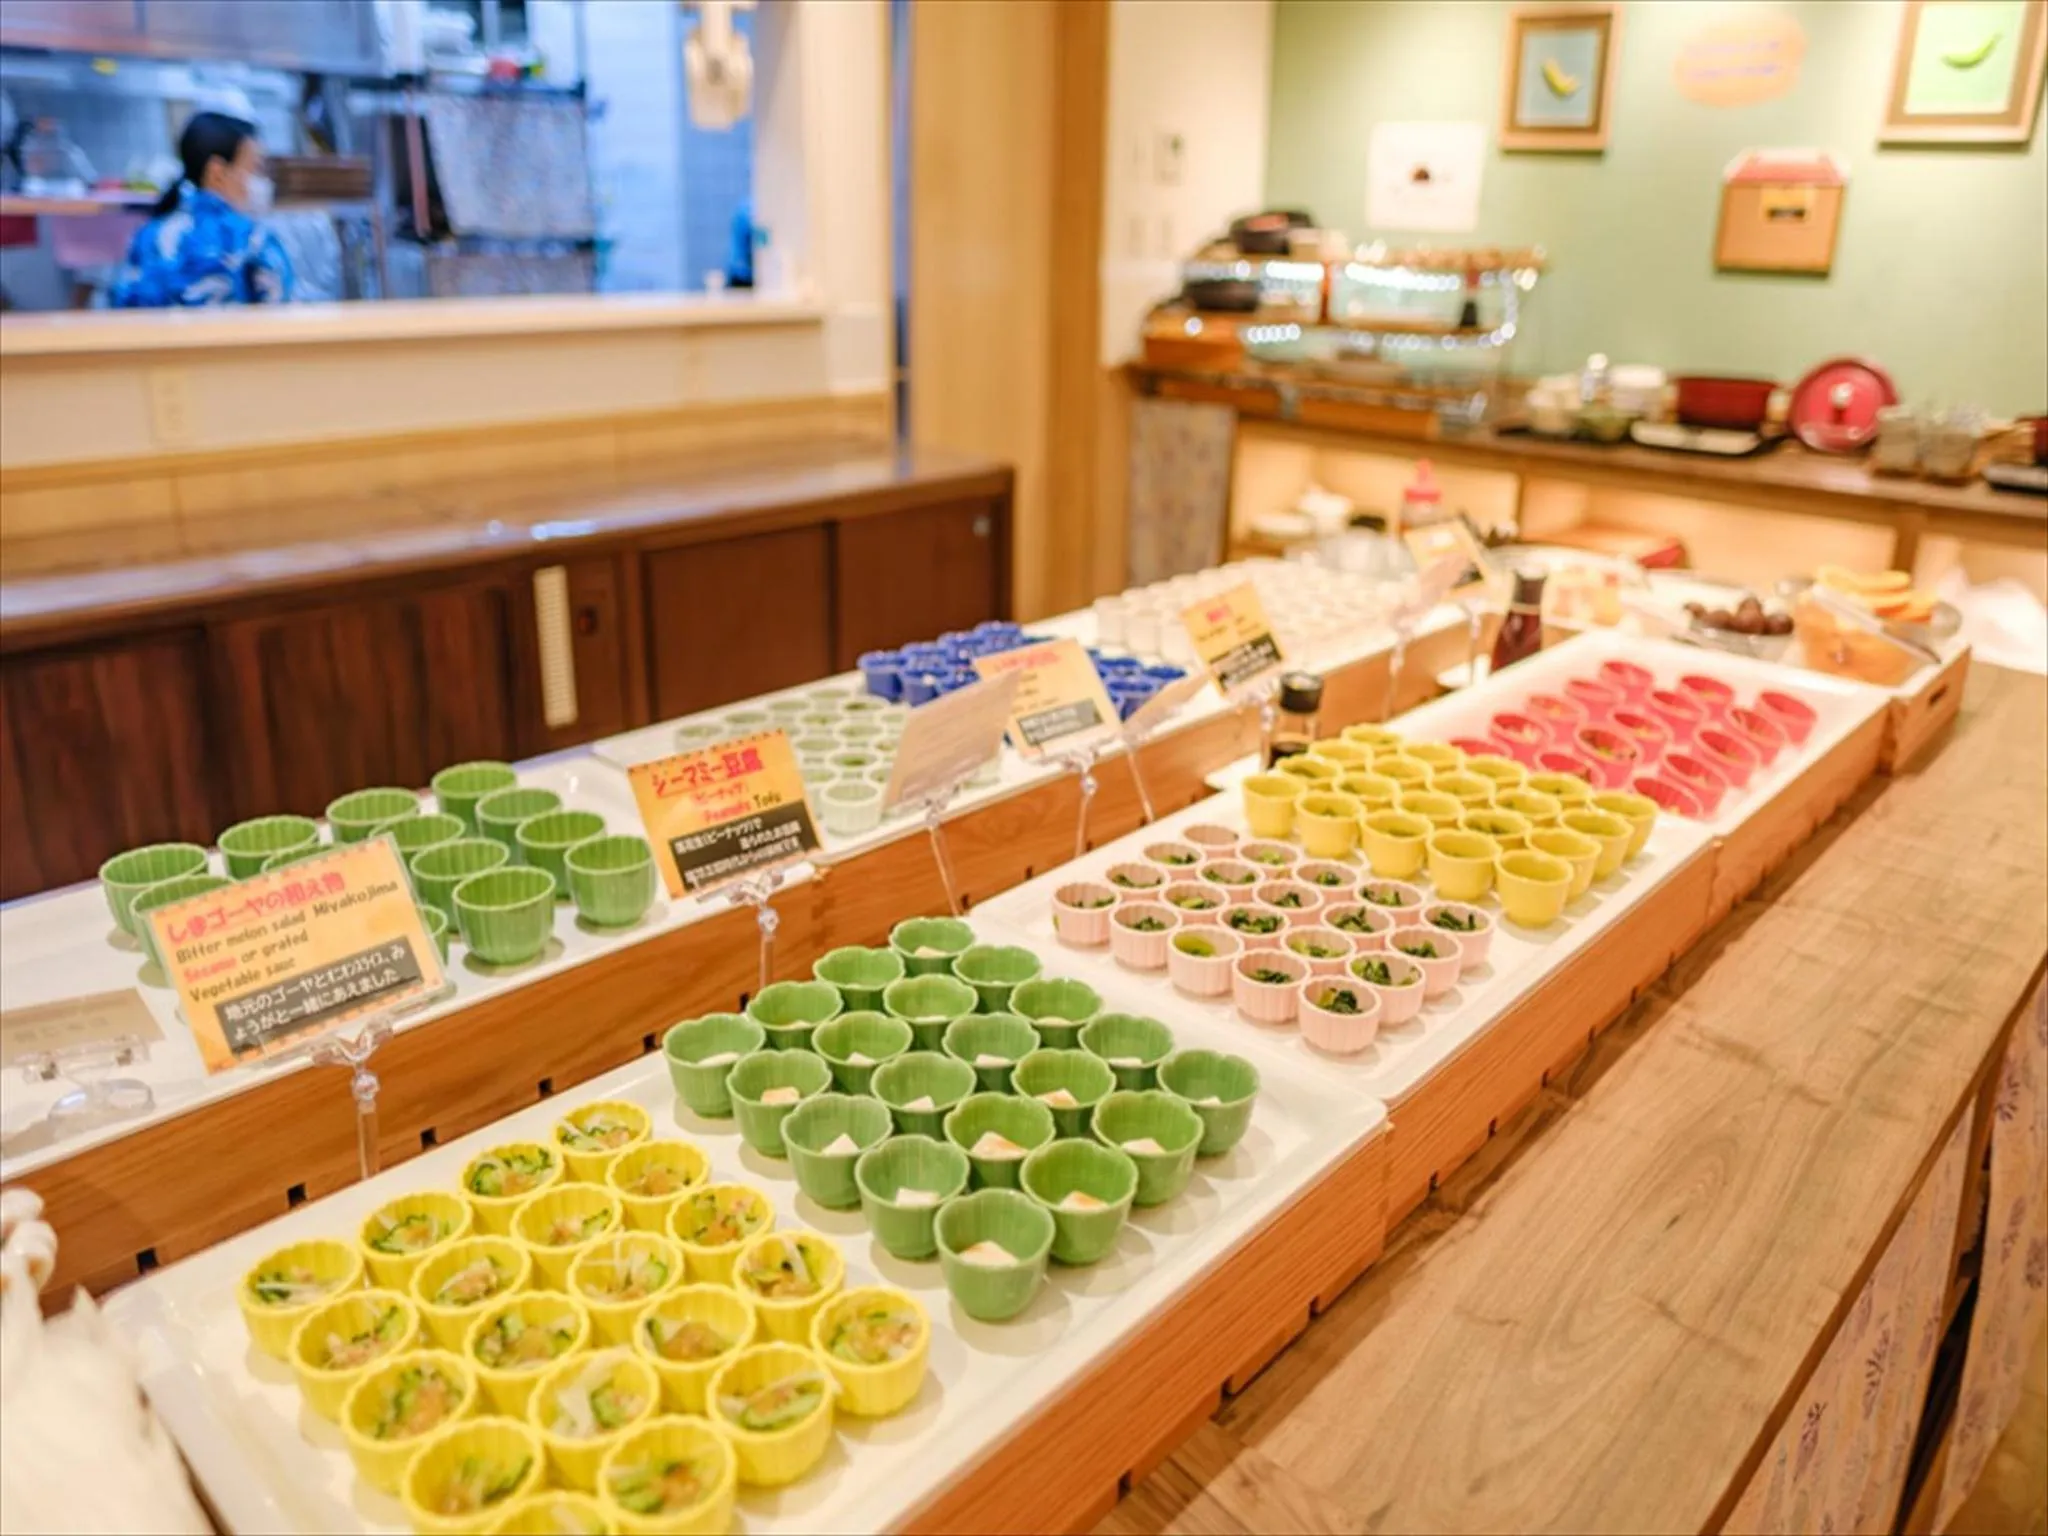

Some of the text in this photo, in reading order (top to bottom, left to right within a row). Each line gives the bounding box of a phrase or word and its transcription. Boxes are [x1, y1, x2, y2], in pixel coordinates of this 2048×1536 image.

[176, 880, 399, 964] Bitter melon salad Miyakojima
[241, 949, 258, 963] or
[261, 929, 308, 957] grated
[190, 969, 261, 1002] Vegetable
